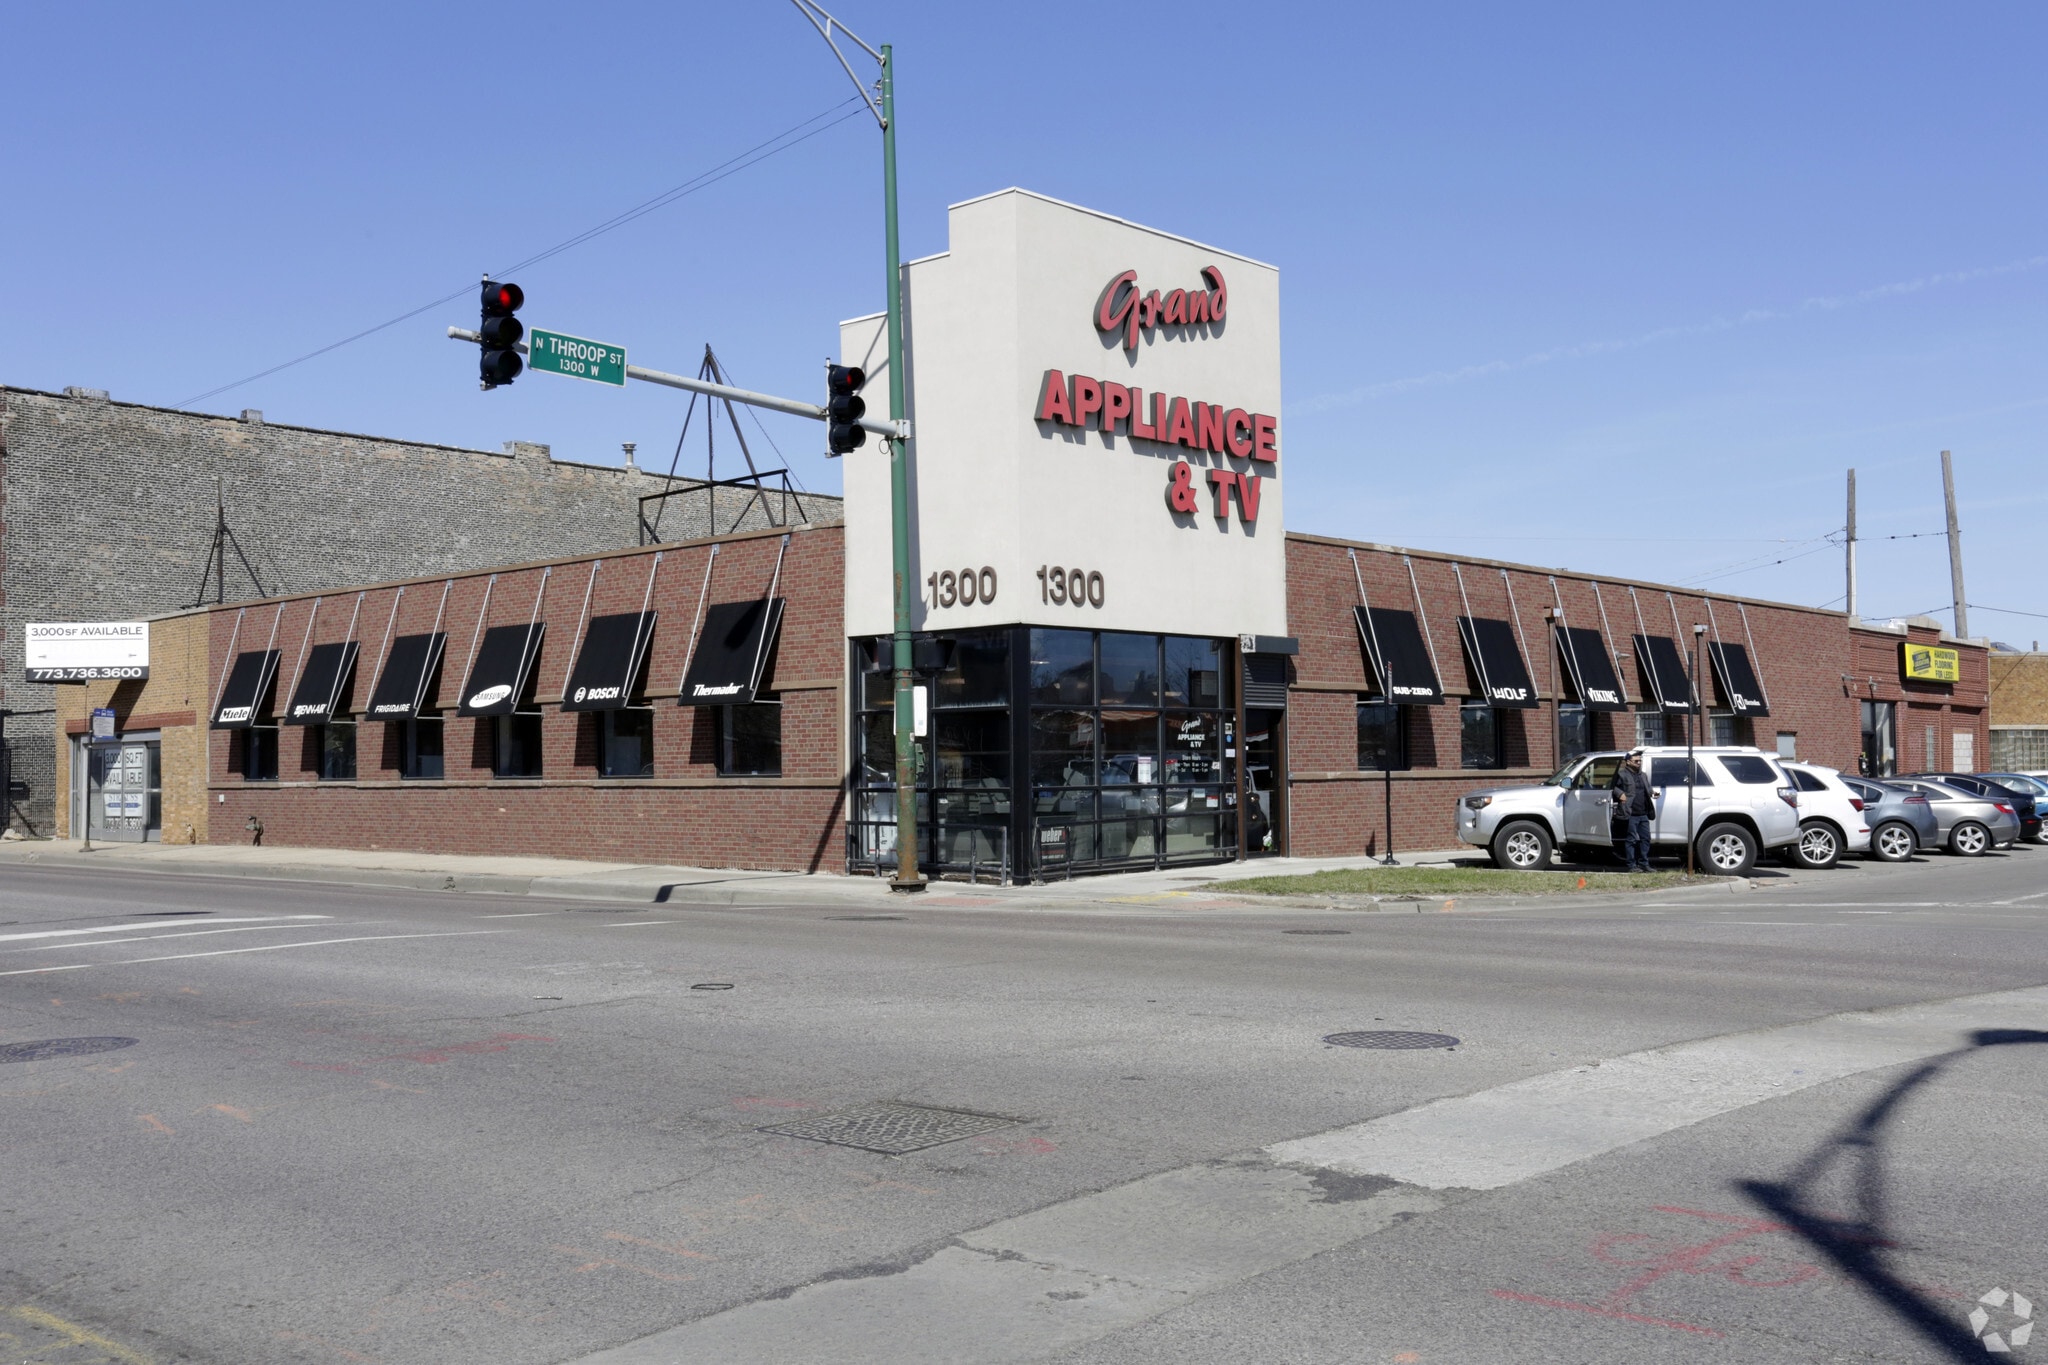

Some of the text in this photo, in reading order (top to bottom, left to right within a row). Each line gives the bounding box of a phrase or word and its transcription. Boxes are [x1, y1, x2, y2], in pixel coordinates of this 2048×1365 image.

[1094, 265, 1228, 350] Grand
[536, 337, 622, 365] N THROOP ST
[560, 358, 600, 377] 1300 W
[1035, 368, 1278, 463] APPLIANCE
[1165, 460, 1262, 522] & TV
[927, 566, 996, 607] 1300
[1037, 565, 1105, 608] 1300
[80, 626, 143, 636] AVAILABLE
[32, 667, 142, 679] 773.736.3600
[475, 691, 506, 701] SAMSUNG
[587, 686, 620, 700] BOSCH
[692, 682, 741, 697] Thermador
[1392, 686, 1433, 696] SUB-ZERO
[1491, 687, 1527, 700] WOLF
[1587, 687, 1619, 703] VIKING
[221, 708, 248, 719] Miele
[374, 703, 411, 713] FRIGIDAIRE
